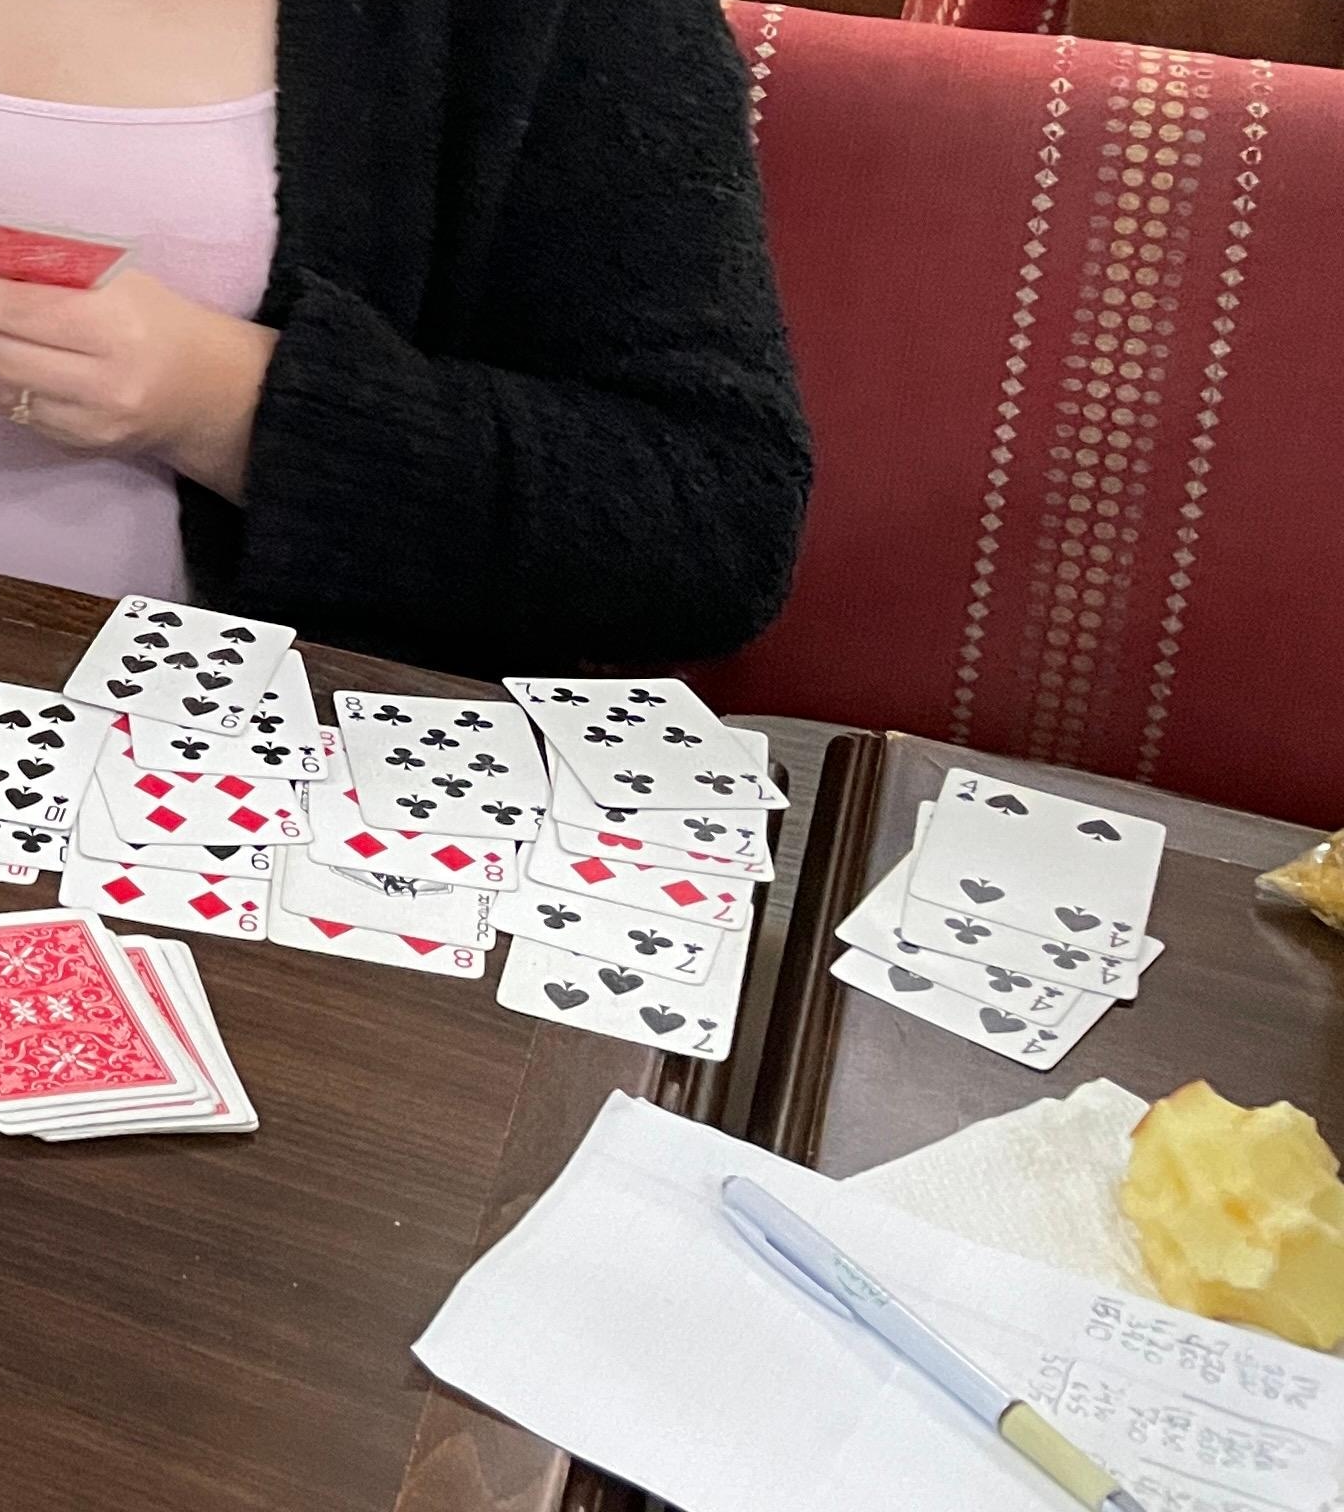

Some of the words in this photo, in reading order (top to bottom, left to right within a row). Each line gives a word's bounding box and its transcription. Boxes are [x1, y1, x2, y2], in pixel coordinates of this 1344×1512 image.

[130, 600, 148, 612] 9
[346, 697, 362, 711] 8
[757, 784, 776, 800] 7
[960, 780, 977, 793] 4
[44, 805, 66, 822] 10
[736, 841, 755, 857] 7
[485, 865, 503, 882] 8
[713, 905, 734, 922] 7
[1110, 932, 1130, 947] 4
[453, 949, 473, 968] 8
[675, 956, 696, 974] 7
[1102, 967, 1120, 984] 4
[1030, 996, 1053, 1011] 4
[693, 1033, 714, 1053] 7
[1021, 1040, 1047, 1054] 4
